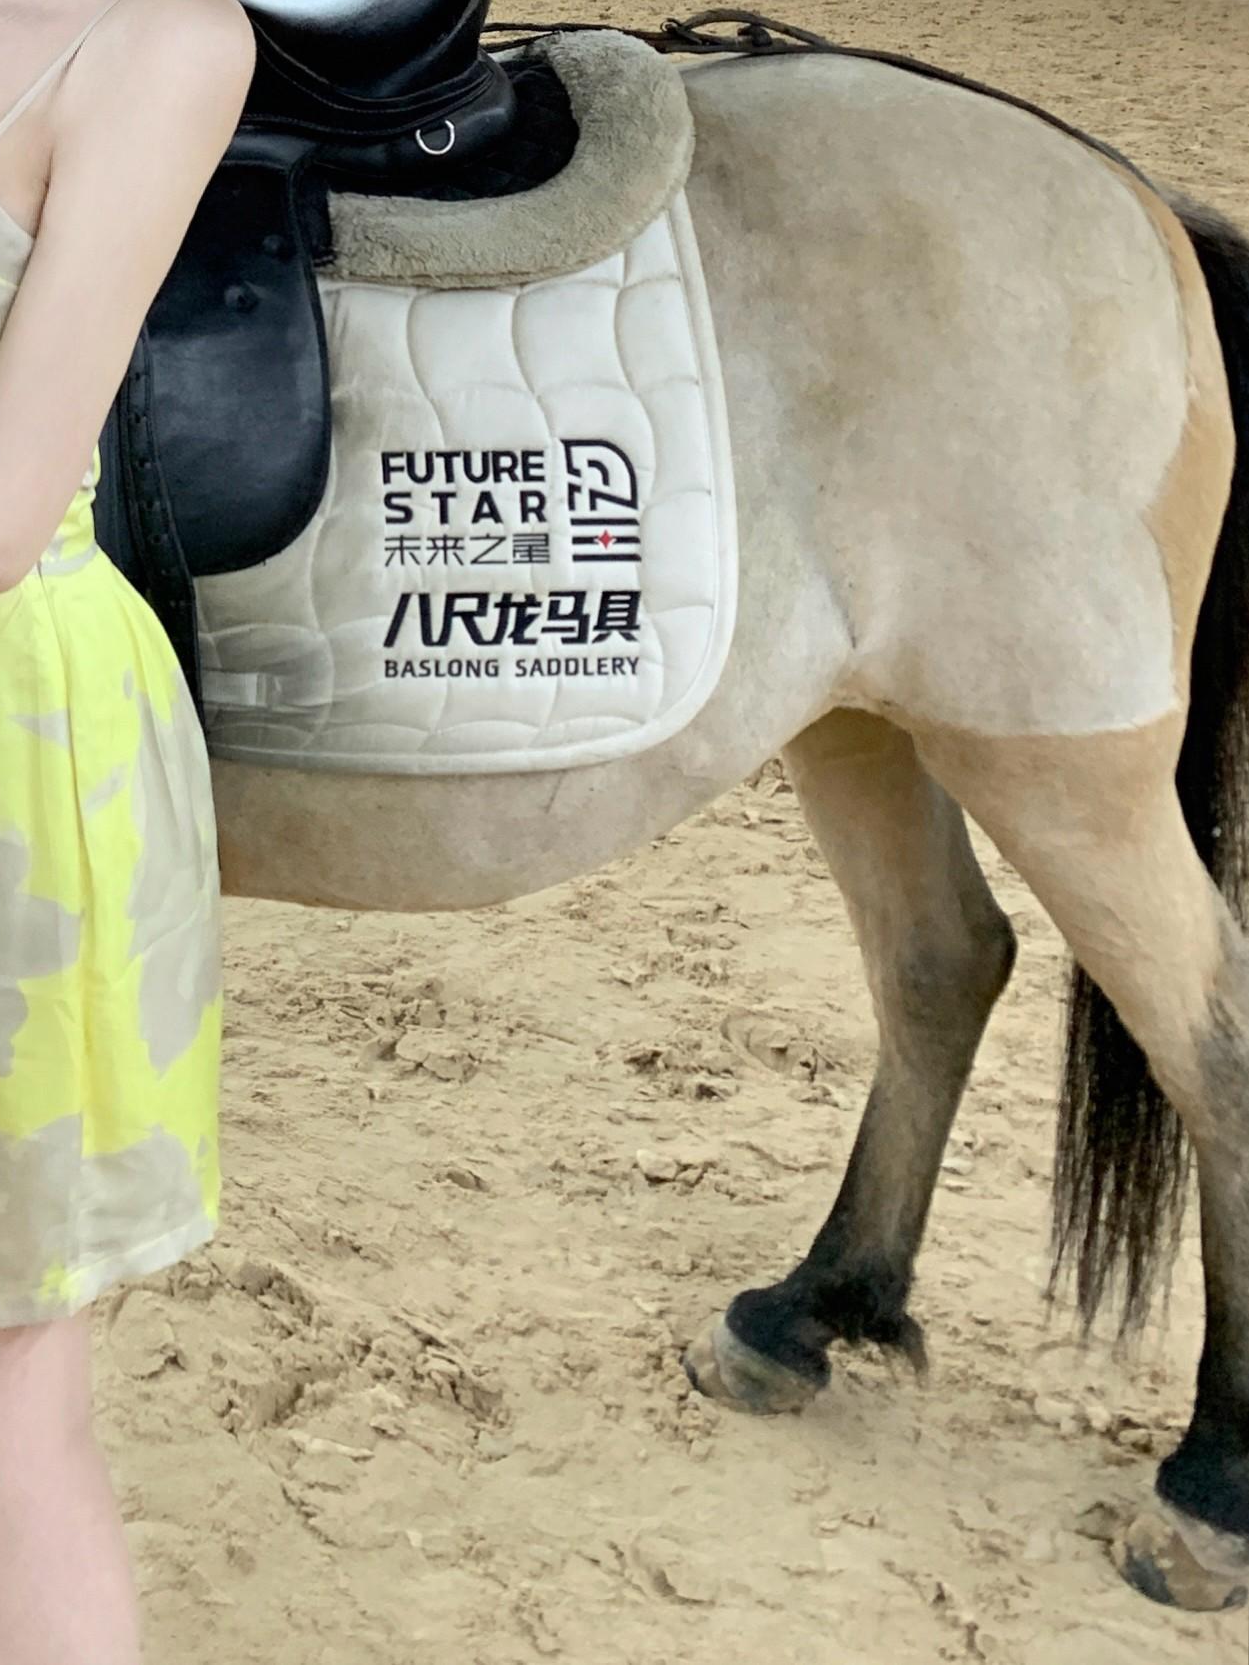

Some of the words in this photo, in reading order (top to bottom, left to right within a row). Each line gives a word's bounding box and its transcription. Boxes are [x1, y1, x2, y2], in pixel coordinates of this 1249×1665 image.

[381, 449, 546, 484] FUTURE
[383, 489, 548, 525] STAR
[383, 532, 551, 567] 未来之星
[383, 590, 642, 648] 八尺龙马具
[383, 657, 500, 679] BASLONG
[514, 655, 641, 678] SADDLERY
